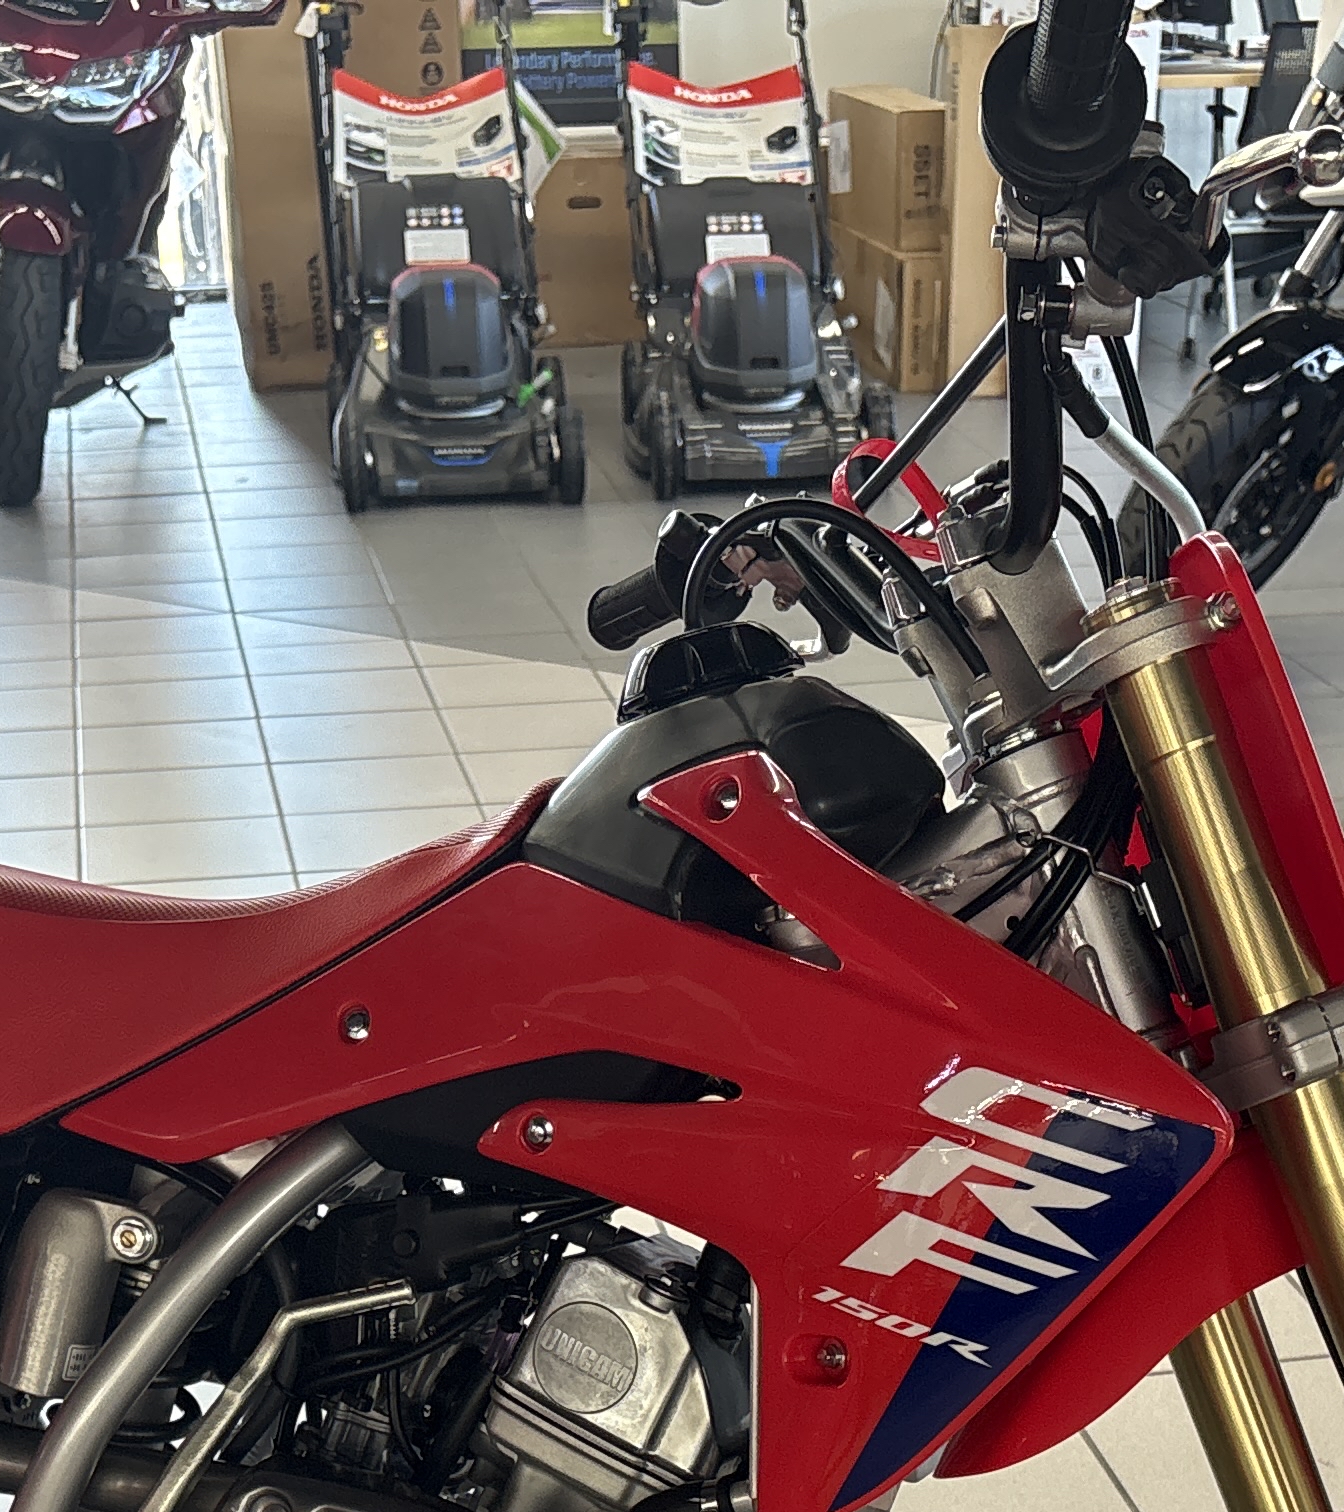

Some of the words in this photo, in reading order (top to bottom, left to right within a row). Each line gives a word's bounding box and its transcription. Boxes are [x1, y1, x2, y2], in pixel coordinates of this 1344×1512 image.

[378, 94, 459, 111] HONDA
[673, 85, 753, 103] HONDA
[840, 1066, 1156, 1295] CRF
[540, 1324, 634, 1393] UNICAM
[811, 1285, 993, 1368] 150R
